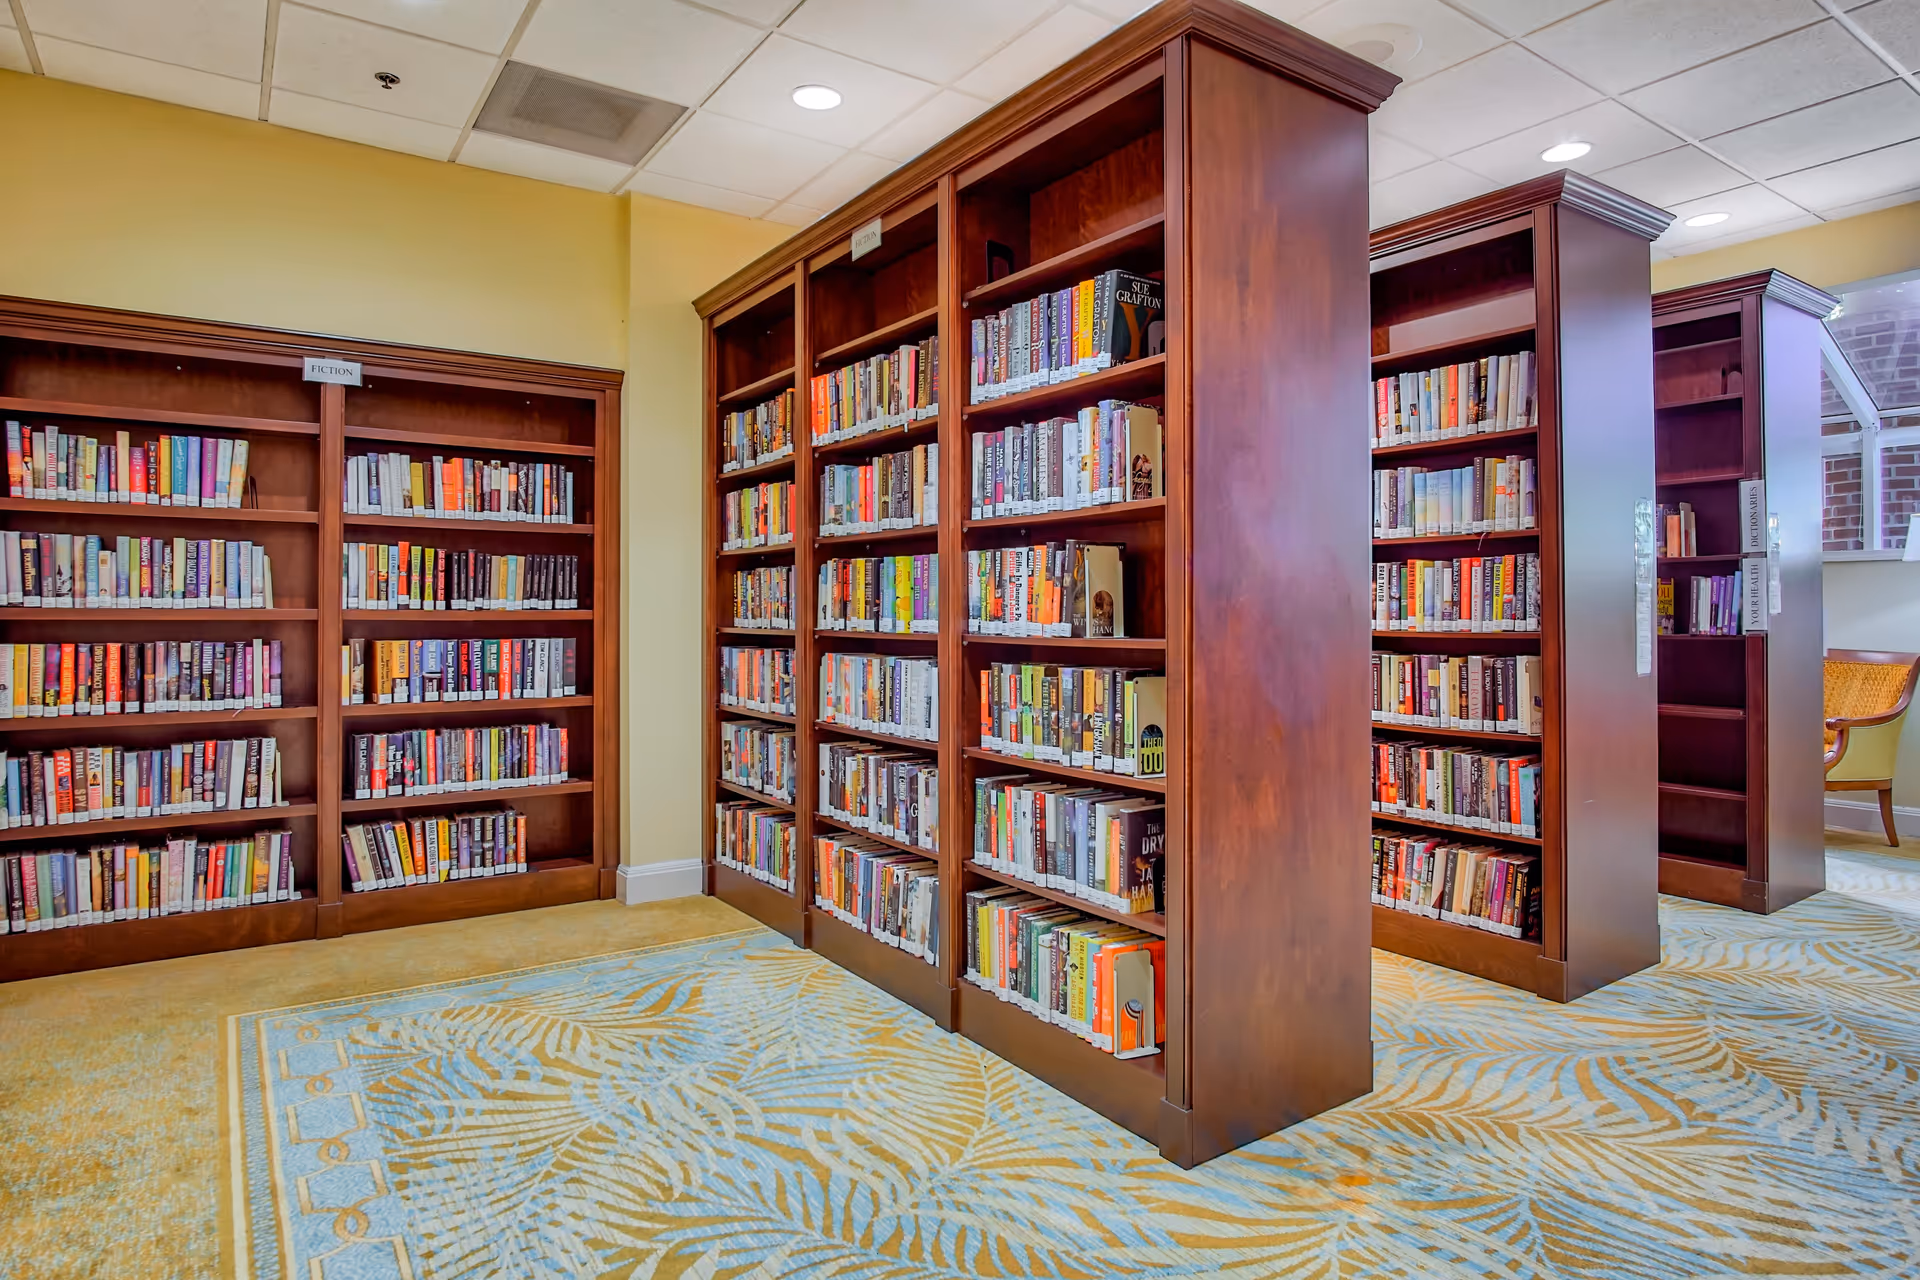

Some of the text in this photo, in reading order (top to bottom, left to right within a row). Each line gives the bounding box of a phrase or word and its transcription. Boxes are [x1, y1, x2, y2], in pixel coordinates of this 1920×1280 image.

[855, 231, 877, 248] FICTION
[1131, 281, 1150, 295] SUE
[1116, 289, 1162, 309] GRAFTON
[311, 364, 353, 377] FICTION
[1750, 486, 1758, 547] DICTIONARIES
[1750, 564, 1759, 624] YOUR HEALTH
[1144, 737, 1162, 748] THEO
[1139, 868, 1152, 882] JA
